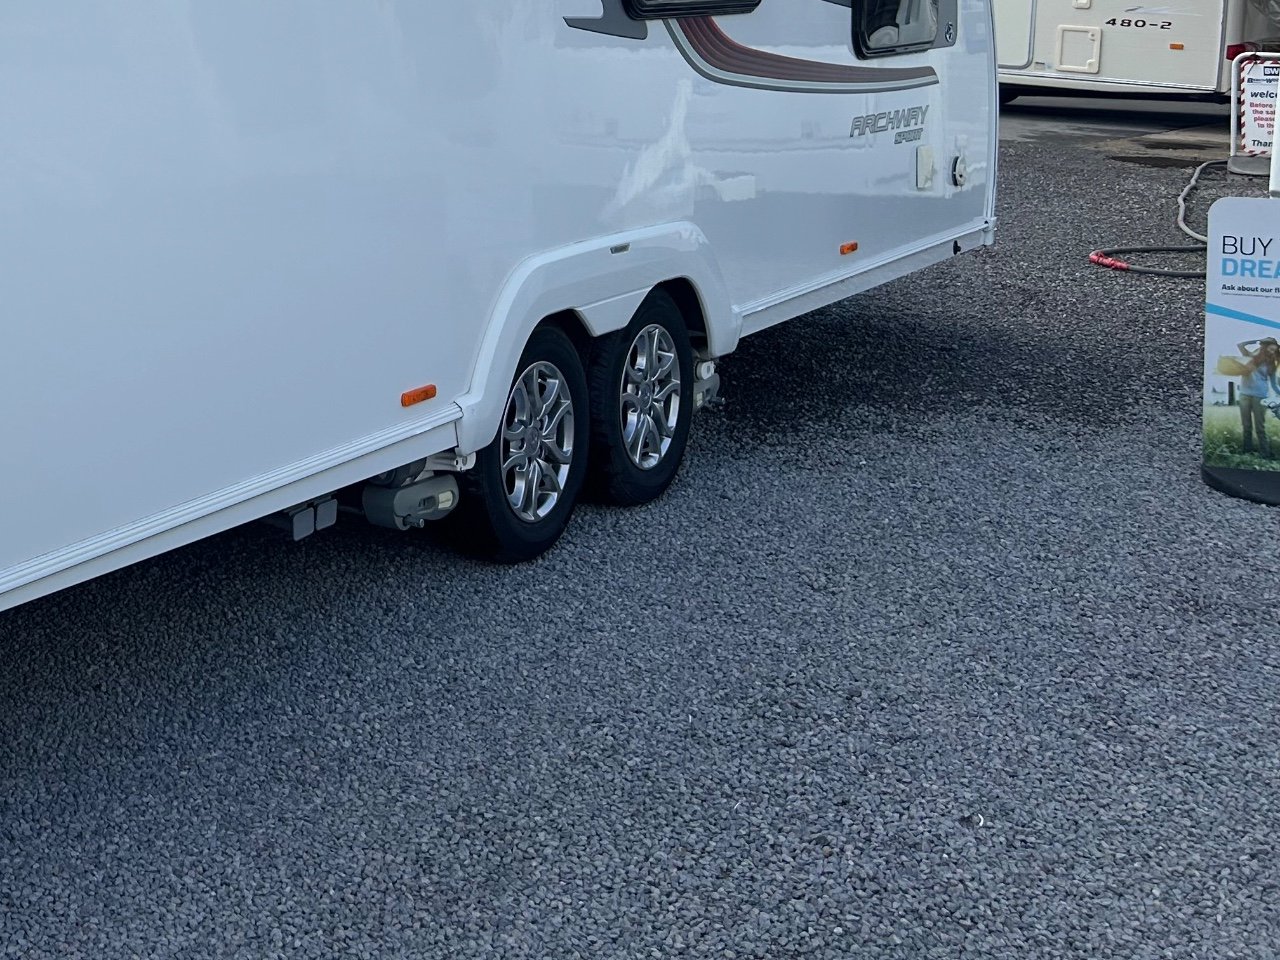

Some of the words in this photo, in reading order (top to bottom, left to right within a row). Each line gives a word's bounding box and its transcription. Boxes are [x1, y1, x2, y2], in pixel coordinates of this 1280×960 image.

[1105, 18, 1172, 29] 480-2
[1250, 90, 1277, 98] welc
[849, 105, 929, 137] ARCHWAY
[1222, 235, 1273, 256] BUY
